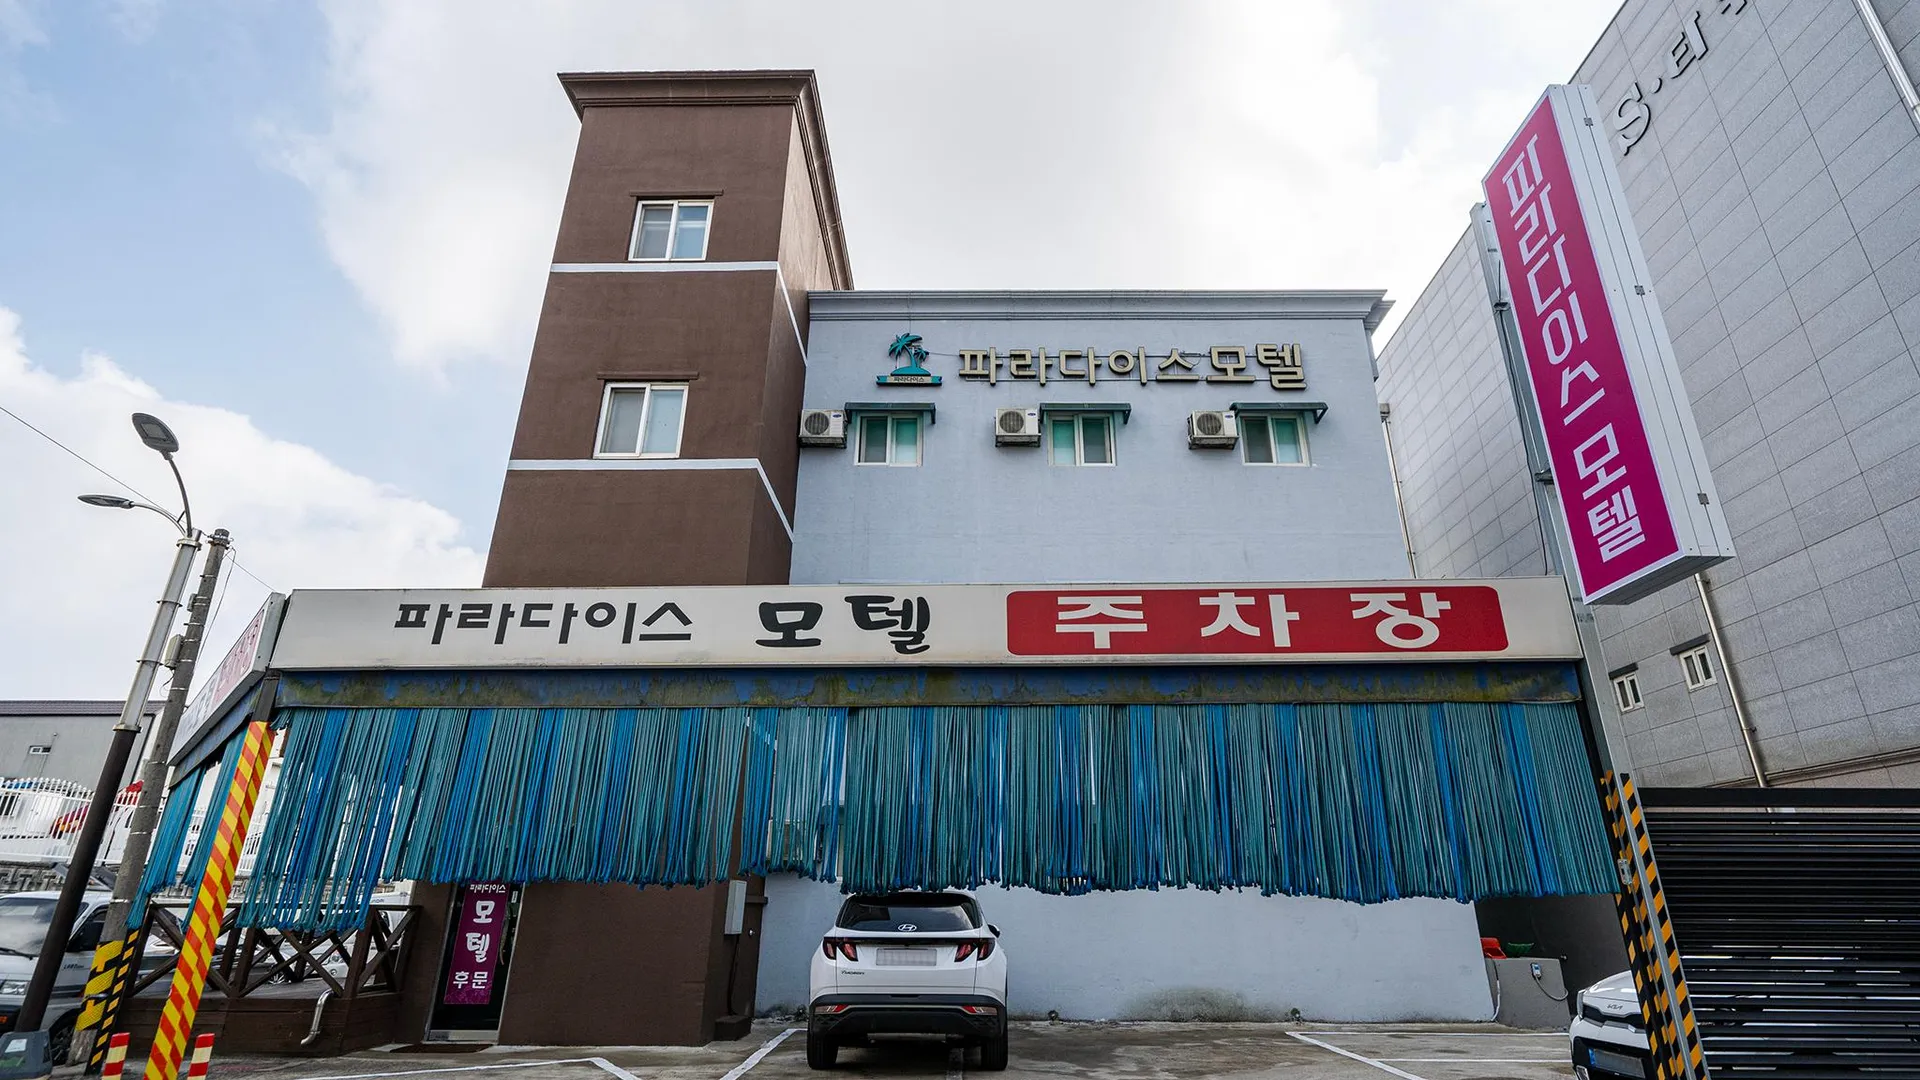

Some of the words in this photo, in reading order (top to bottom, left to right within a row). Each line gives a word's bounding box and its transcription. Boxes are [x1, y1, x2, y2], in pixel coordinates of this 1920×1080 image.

[1502, 133, 1606, 426] 파라다이스
[1573, 422, 1646, 564] 모텔
[394, 602, 693, 645] 파라다이스
[755, 595, 931, 655] 모텔
[1055, 592, 1452, 650] 주차장
[469, 884, 506, 893] 파라다이스
[465, 900, 495, 963] 모텔
[453, 970, 488, 989] 후문
